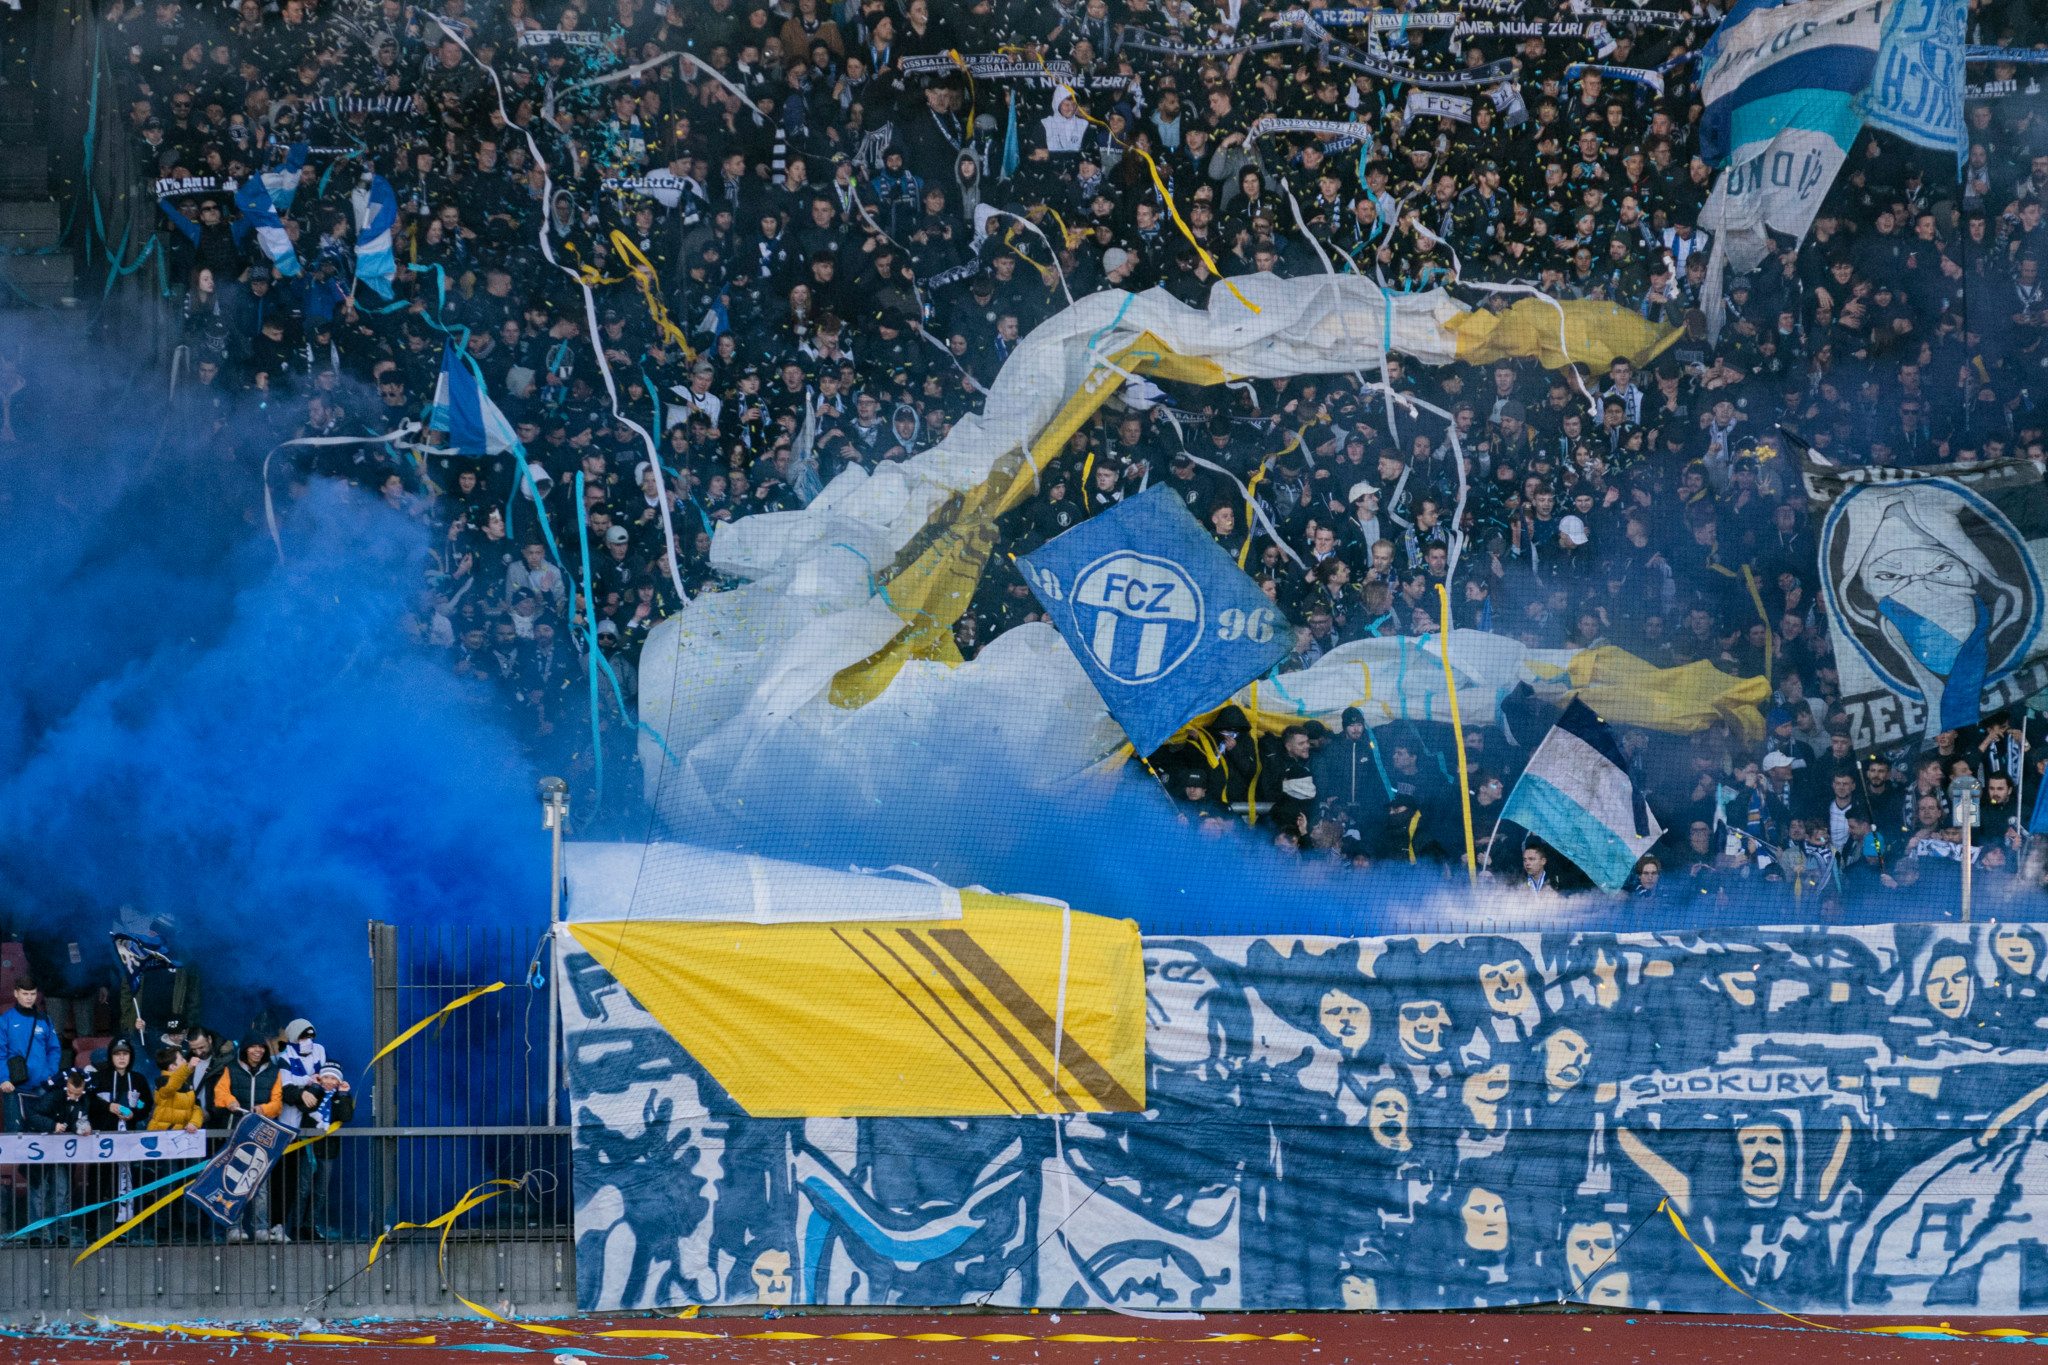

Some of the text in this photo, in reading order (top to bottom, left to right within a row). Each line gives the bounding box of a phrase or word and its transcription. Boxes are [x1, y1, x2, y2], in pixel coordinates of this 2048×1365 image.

[1499, 22, 1543, 35] NUME
[1984, 79, 2017, 93] ANTI
[182, 176, 216, 188] ANTI
[1102, 572, 1176, 614] FCZ
[1217, 607, 1276, 644] 96
[240, 1156, 265, 1190] FCZ
